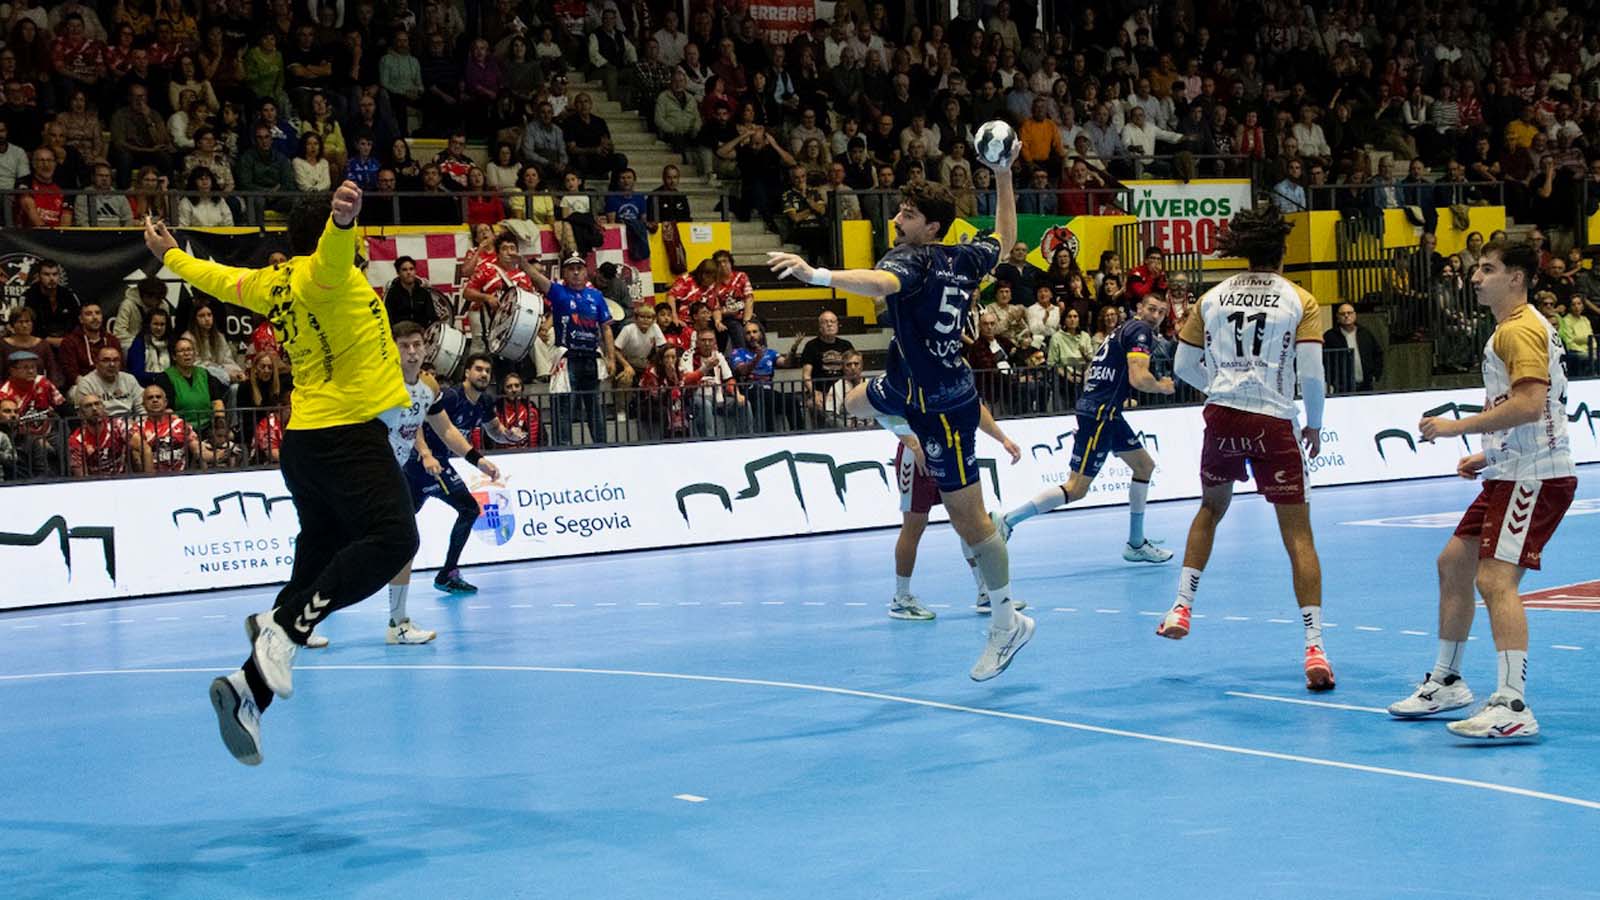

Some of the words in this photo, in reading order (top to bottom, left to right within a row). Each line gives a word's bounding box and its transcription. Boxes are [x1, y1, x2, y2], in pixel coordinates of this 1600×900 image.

[1227, 311, 1267, 357] 11
[517, 482, 625, 510] Diputación
[522, 518, 548, 536] de
[554, 512, 631, 537] Segovia
[184, 537, 280, 557] NUESTROS
[200, 558, 269, 573] NUESTRA
